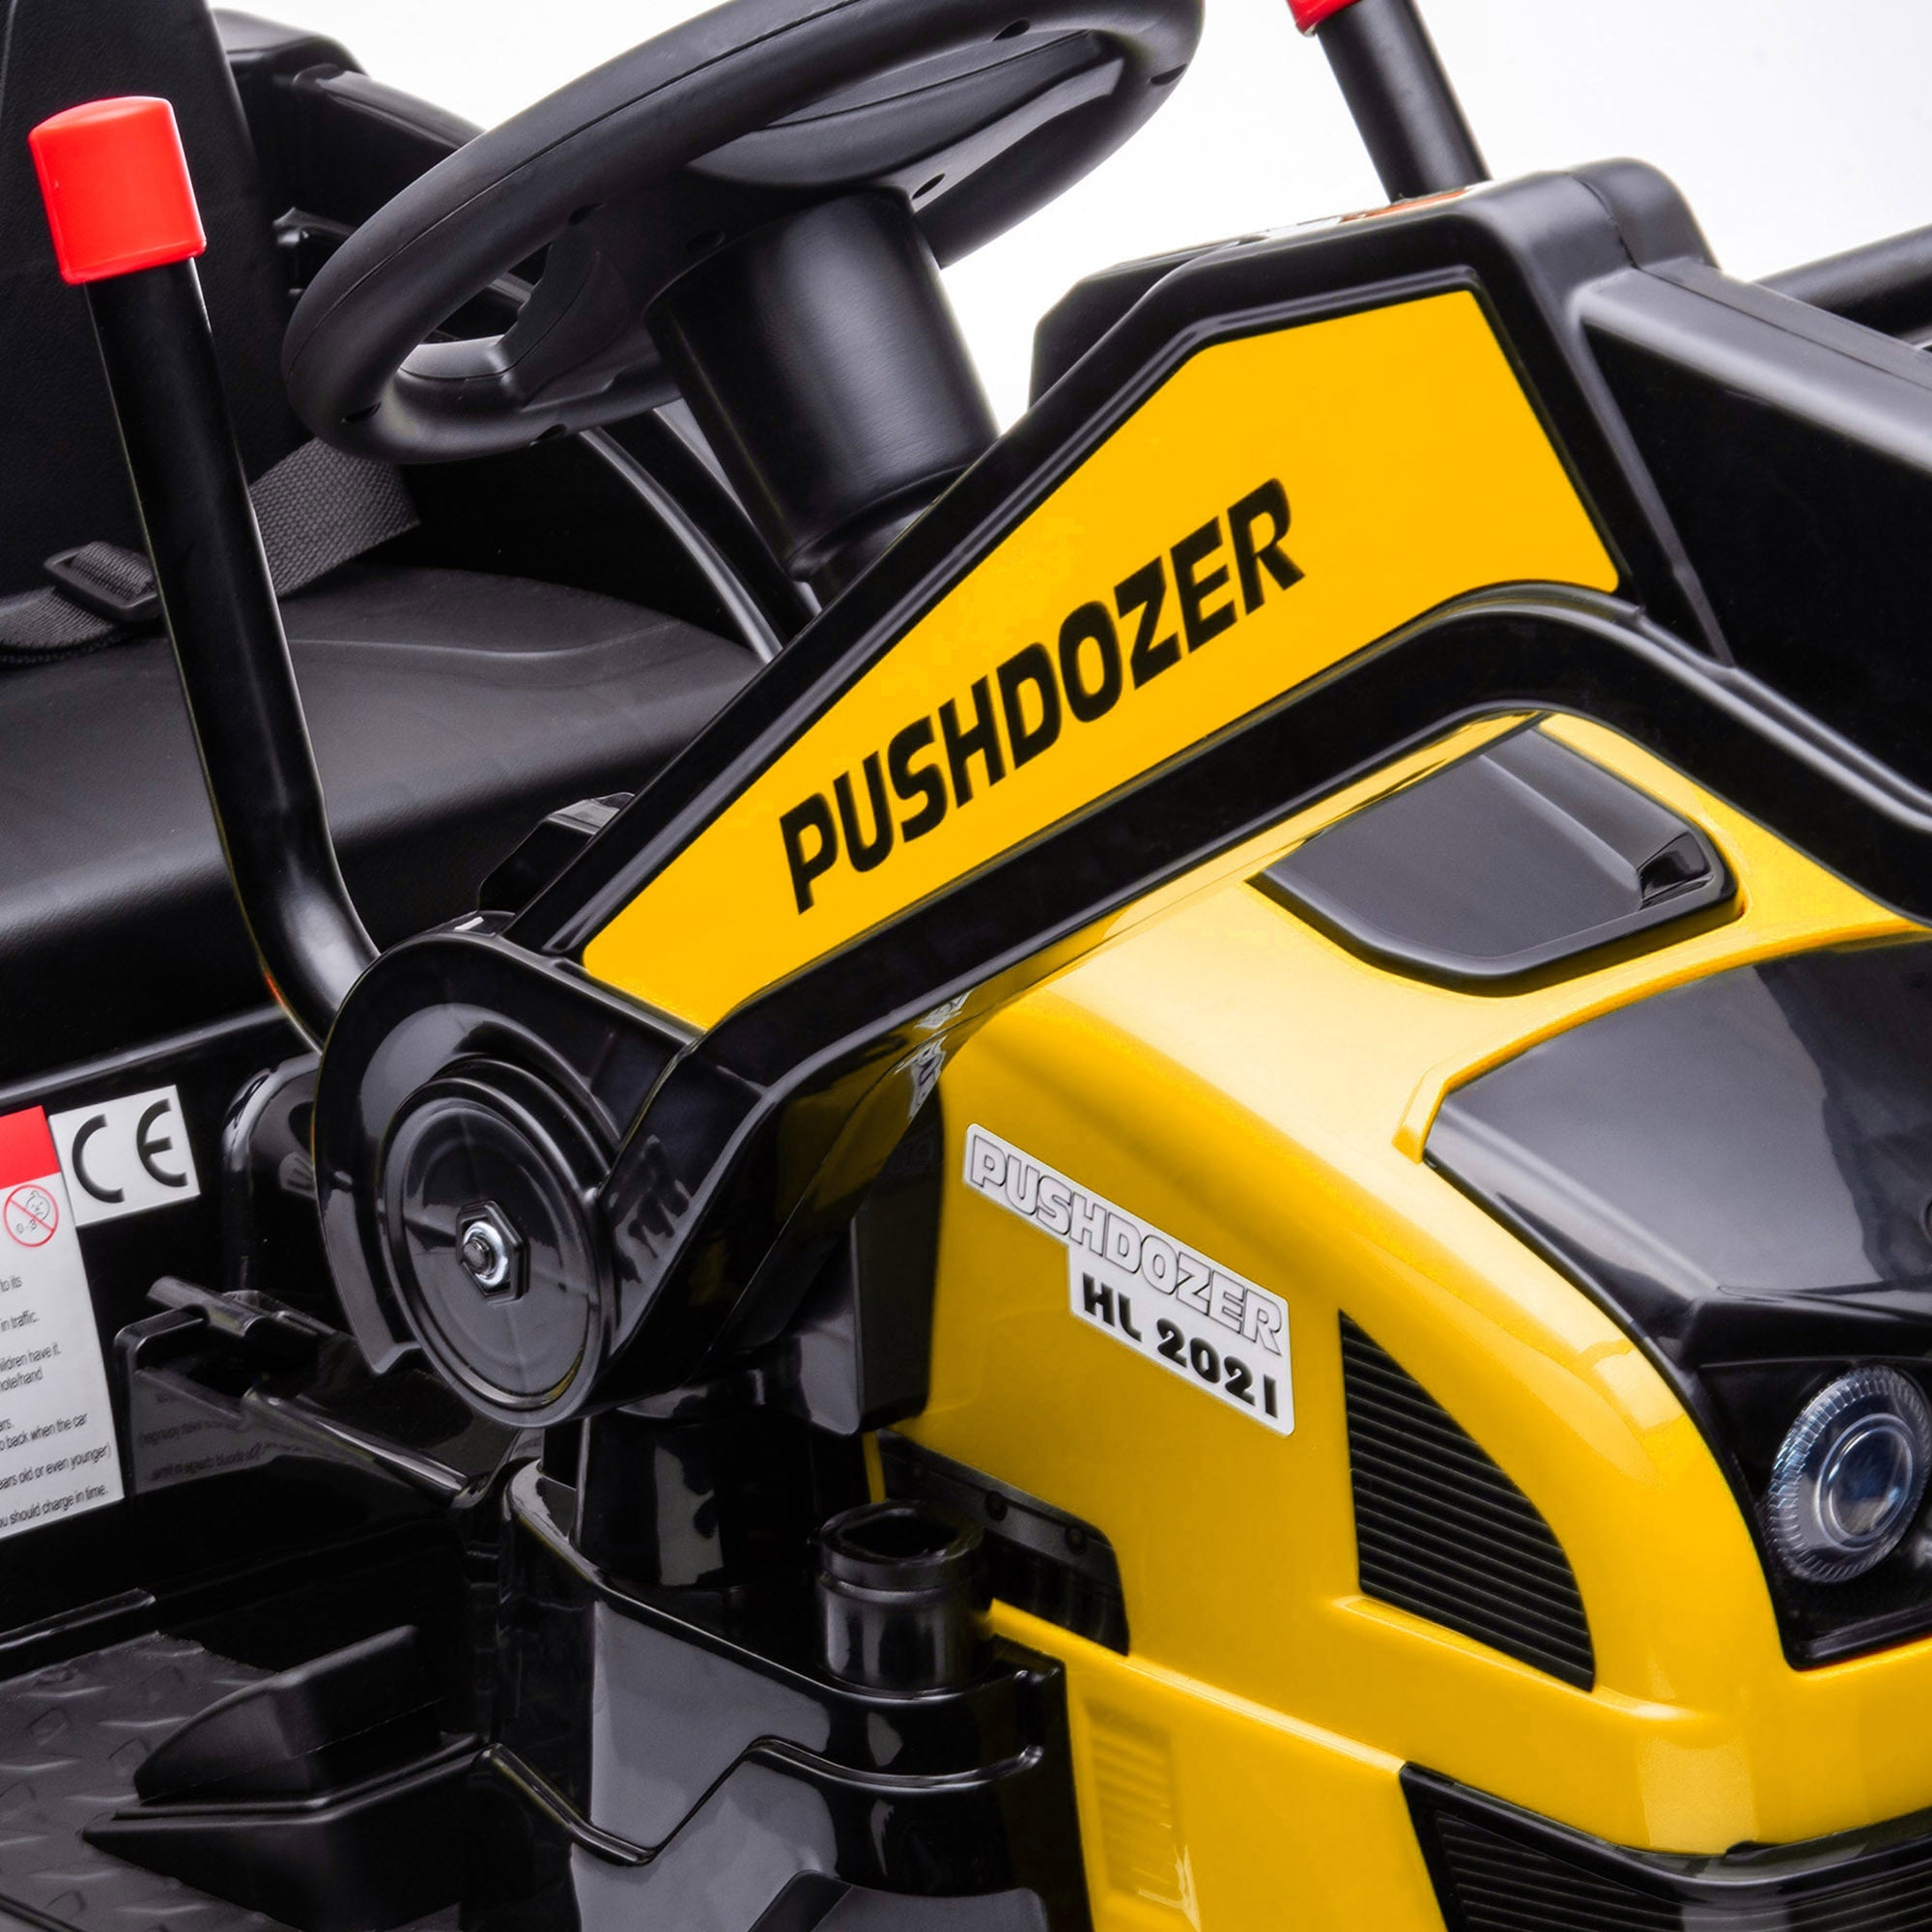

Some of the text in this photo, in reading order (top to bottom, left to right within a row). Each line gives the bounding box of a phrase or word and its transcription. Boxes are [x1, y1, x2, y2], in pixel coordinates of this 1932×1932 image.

[779, 477, 1306, 916] PUSHDOZER
[71, 1097, 188, 1204] CE
[970, 1134, 1283, 1357] PUSHDOZER
[27, 1348, 52, 1363] have
[1082, 1271, 1279, 1419] HL 2021
[6, 1430, 30, 1449] back
[31, 1423, 55, 1441] when
[56, 1417, 71, 1433] the
[72, 1412, 88, 1428] car
[18, 1465, 34, 1484] old
[35, 1464, 44, 1479] or
[45, 1458, 69, 1475] even
[71, 1441, 111, 1470] younger)
[10, 1501, 41, 1524] should
[42, 1493, 74, 1513] charge
[74, 1489, 85, 1504] in
[85, 1484, 108, 1501] time.
